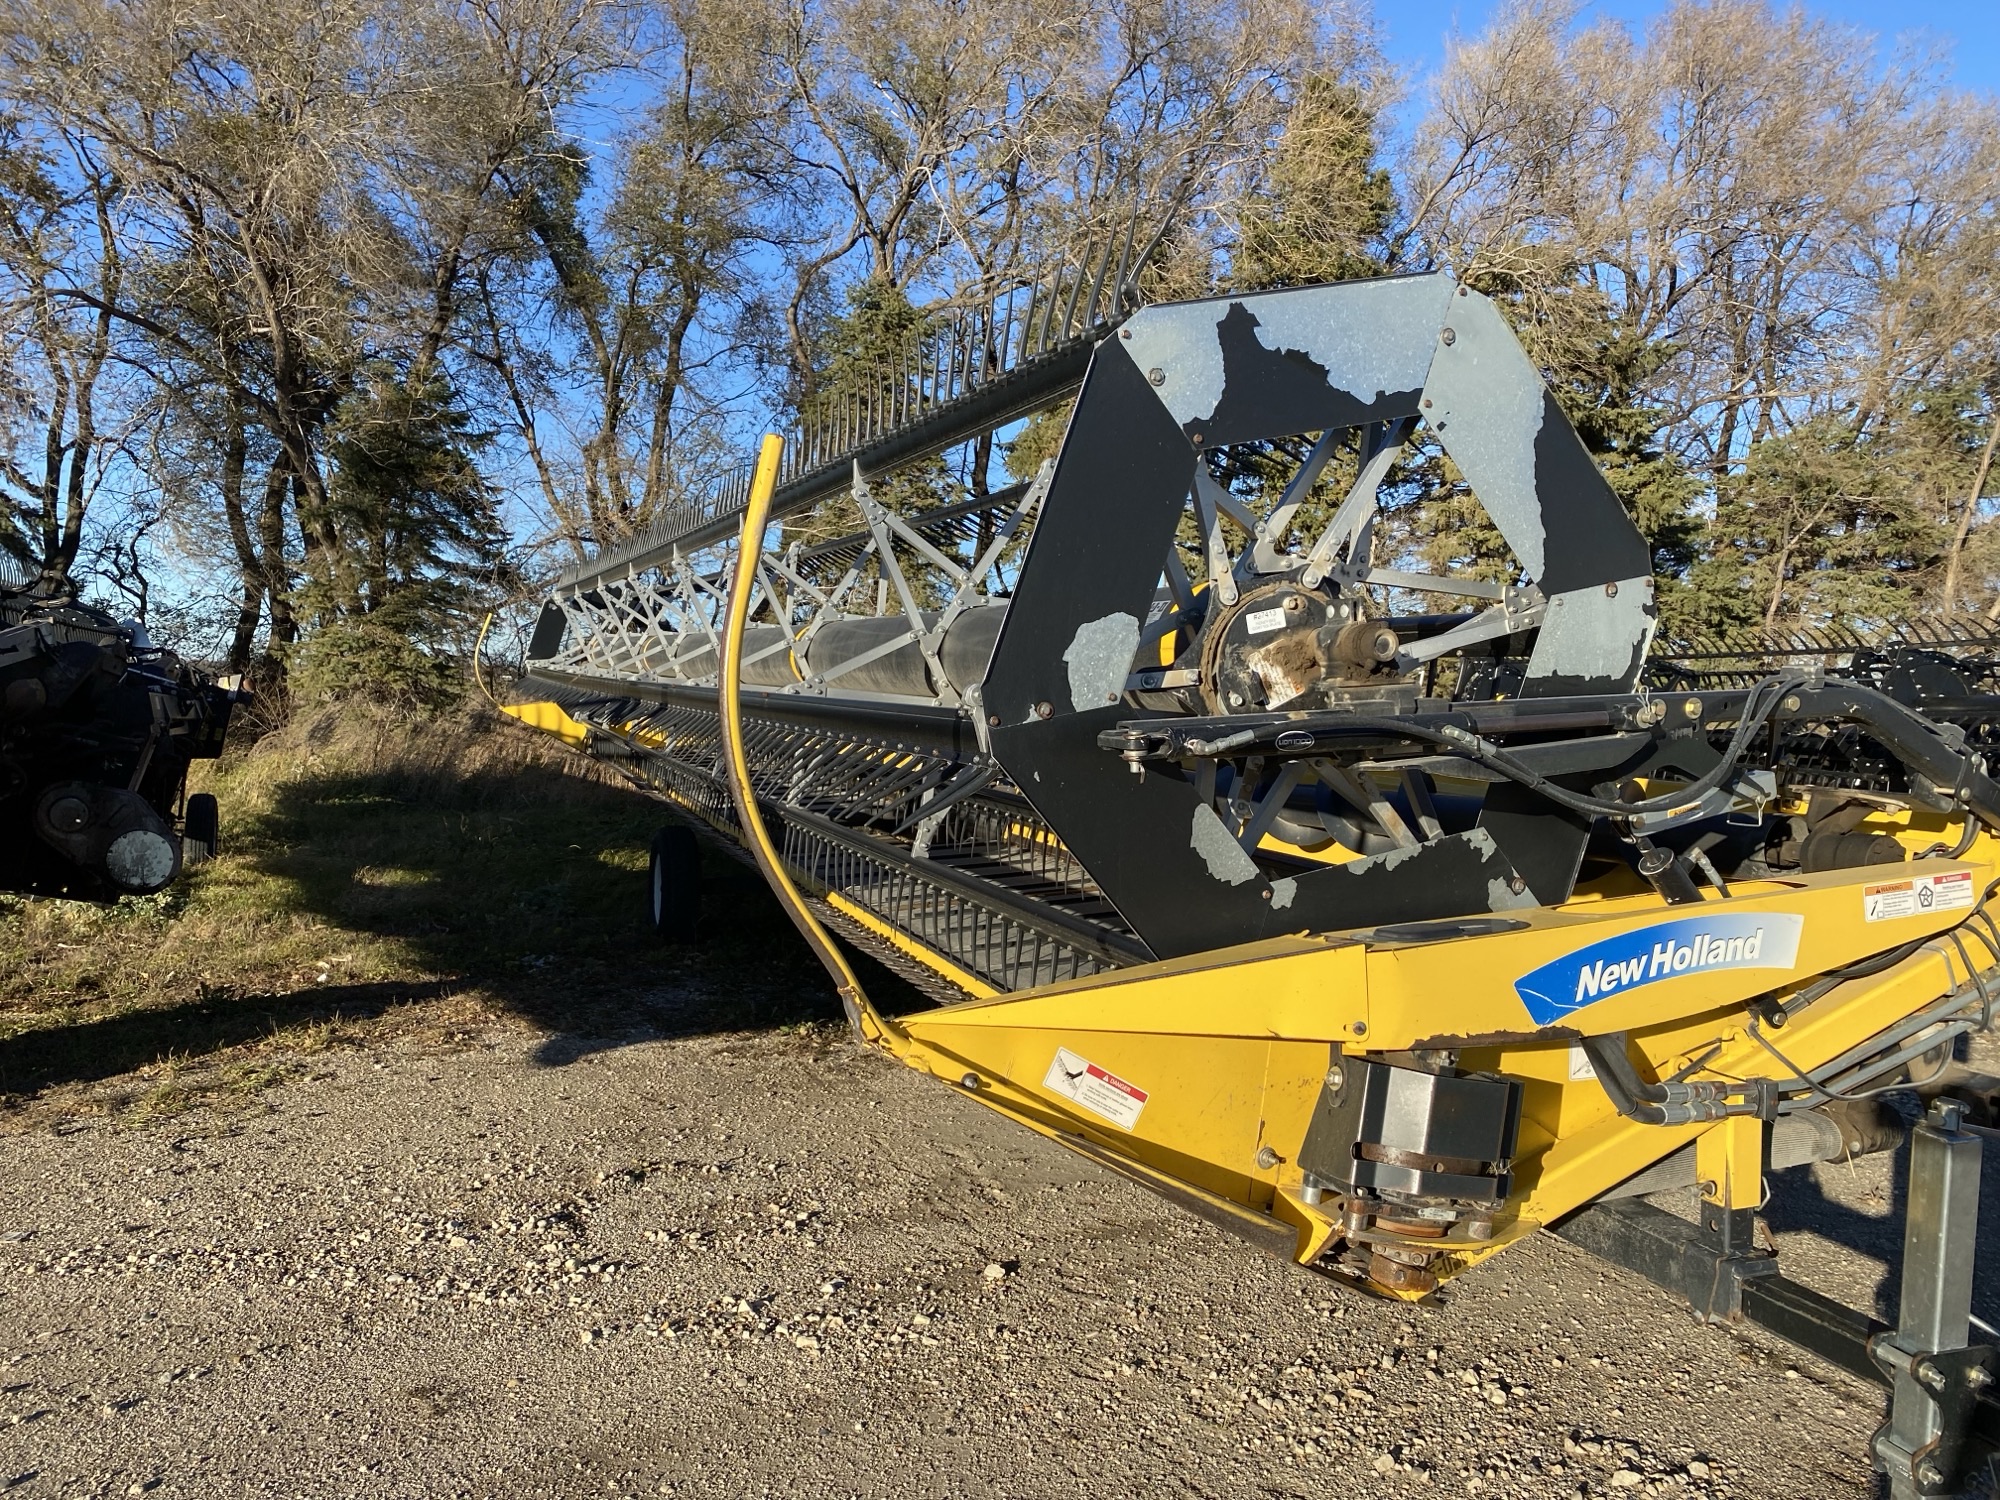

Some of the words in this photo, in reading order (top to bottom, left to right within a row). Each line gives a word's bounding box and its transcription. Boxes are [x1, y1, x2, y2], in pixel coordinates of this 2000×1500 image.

[1880, 884, 1902, 892] WARNING
[1575, 954, 1648, 1002] New
[1649, 928, 1763, 977] Holland
[1109, 1078, 1132, 1093] DANGER
